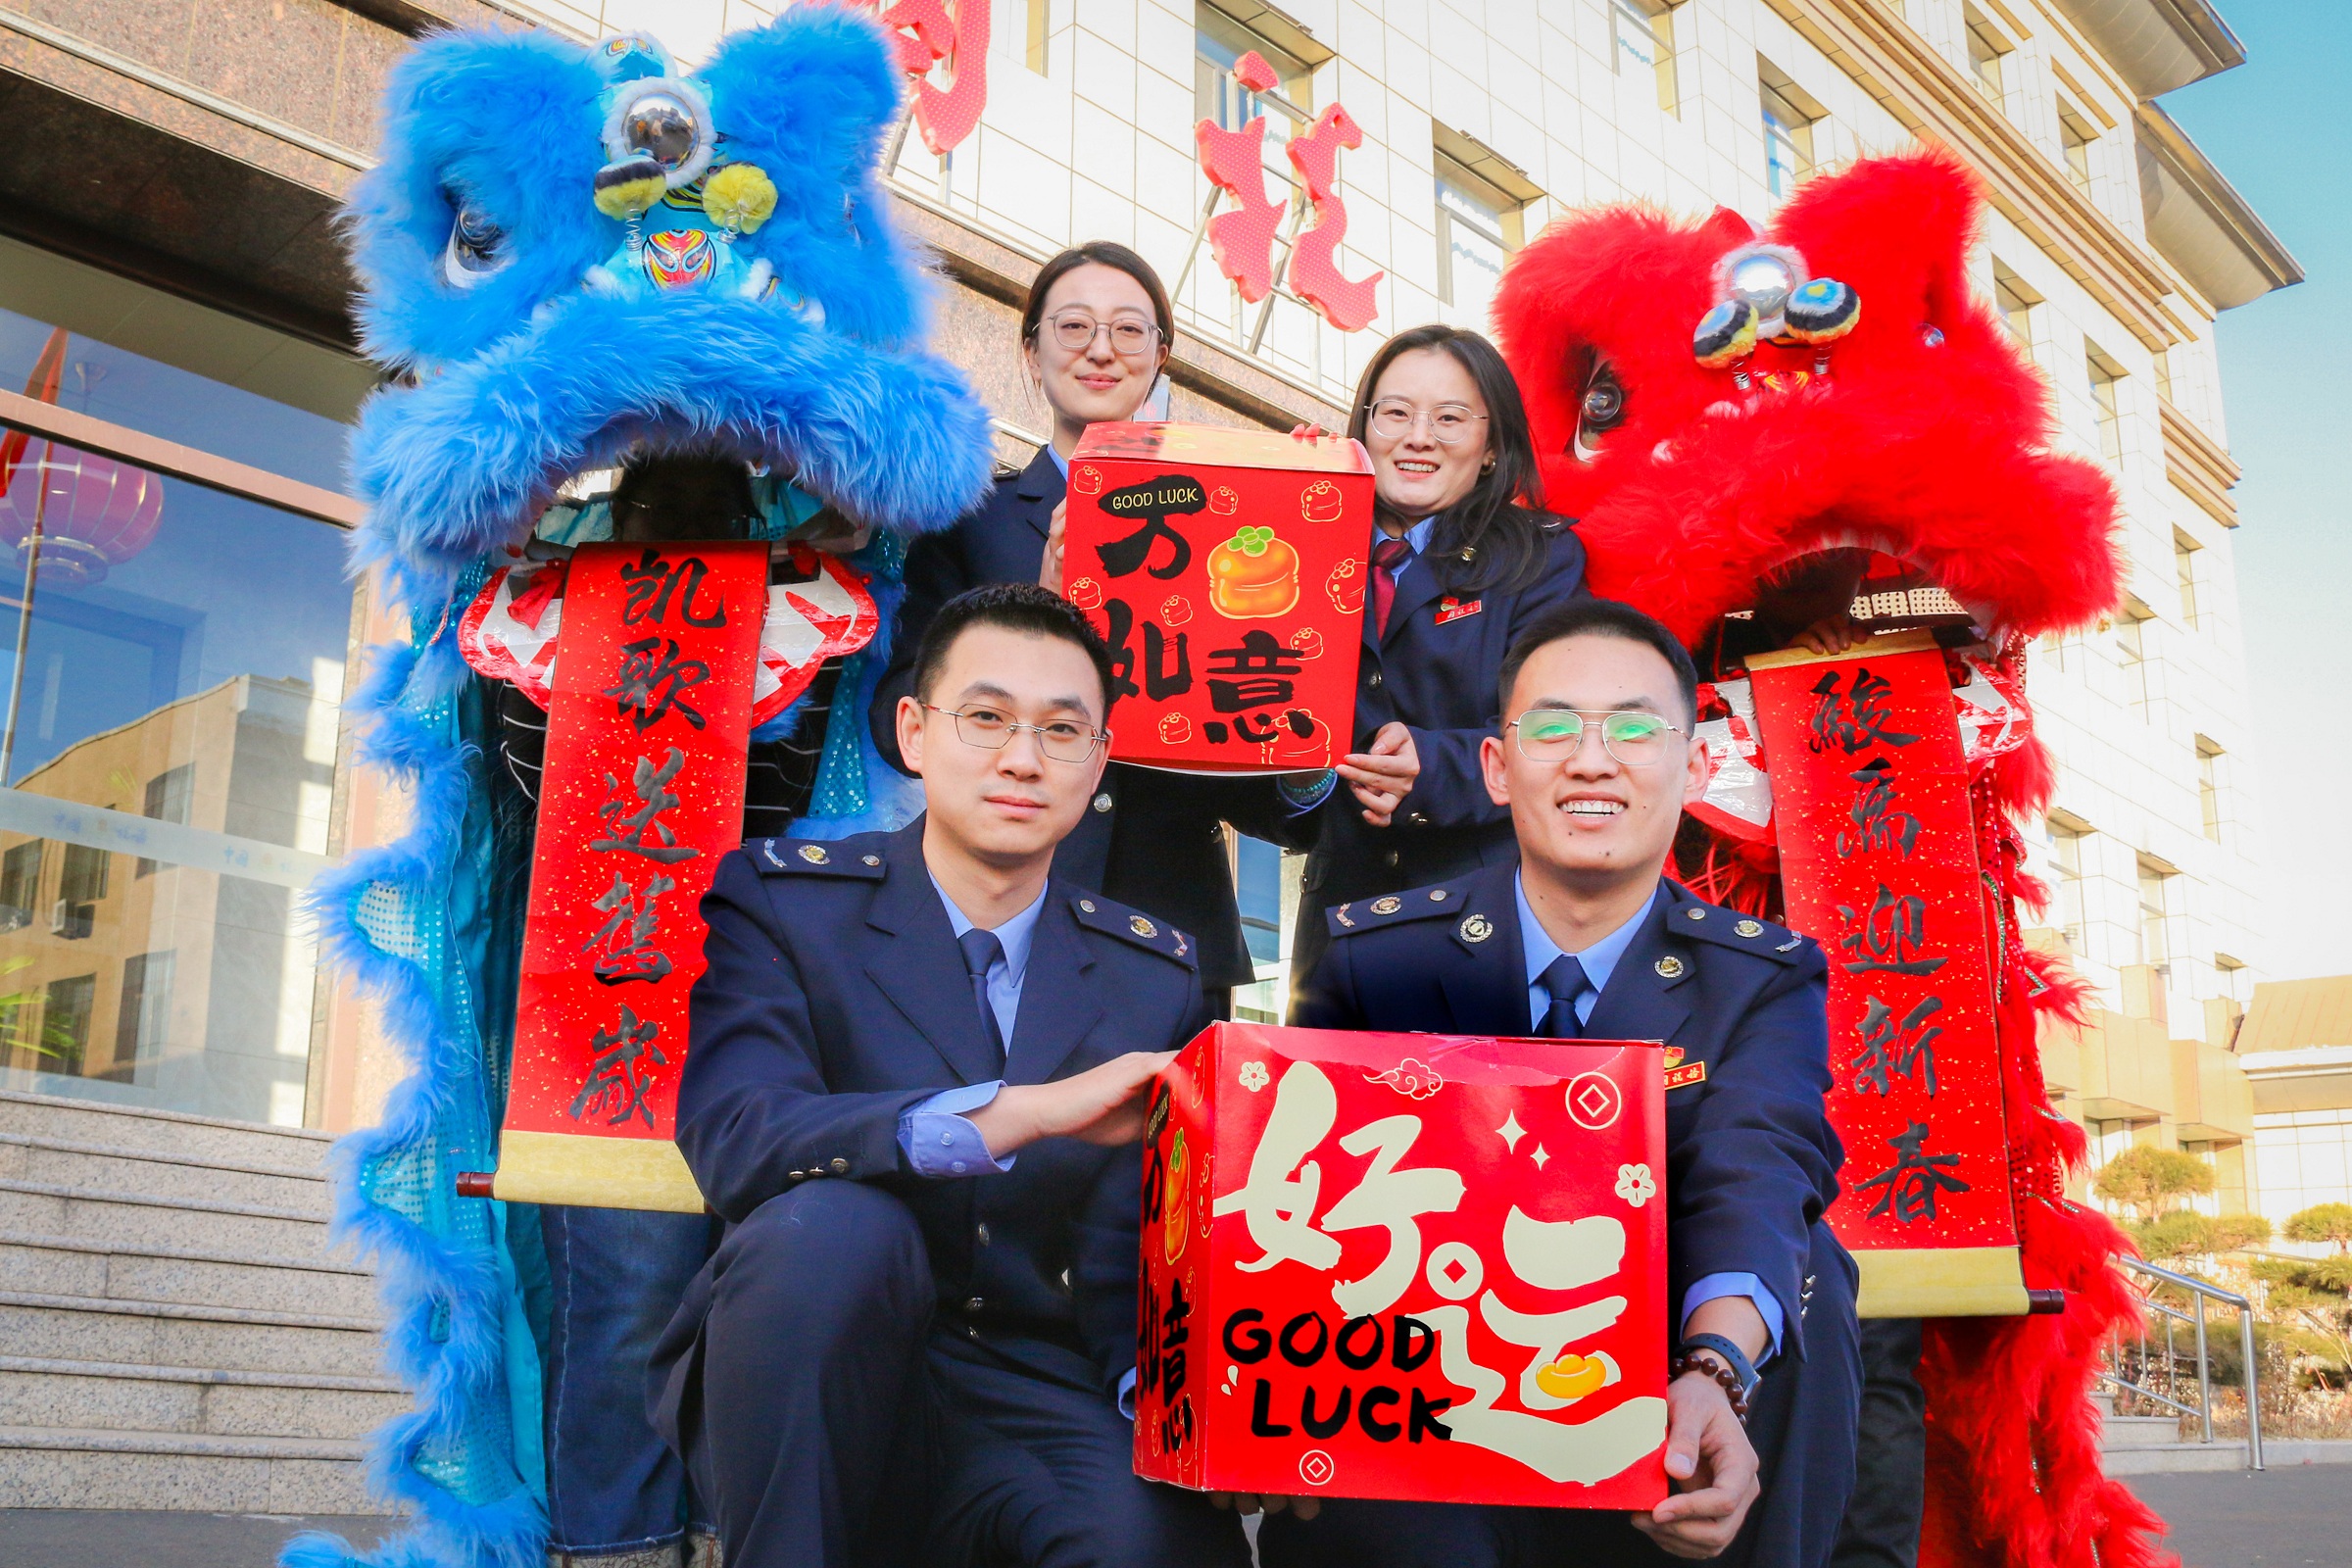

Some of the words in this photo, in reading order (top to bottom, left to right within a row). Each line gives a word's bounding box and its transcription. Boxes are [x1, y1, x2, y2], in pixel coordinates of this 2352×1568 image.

[1095, 474, 1208, 580] 万
[1112, 491, 1153, 511] GOOD
[1157, 487, 1200, 506] LUCK
[1103, 599, 1316, 745] 如意
[1221, 1307, 1436, 1373] GOOD
[1250, 1378, 1452, 1445] LUCK
